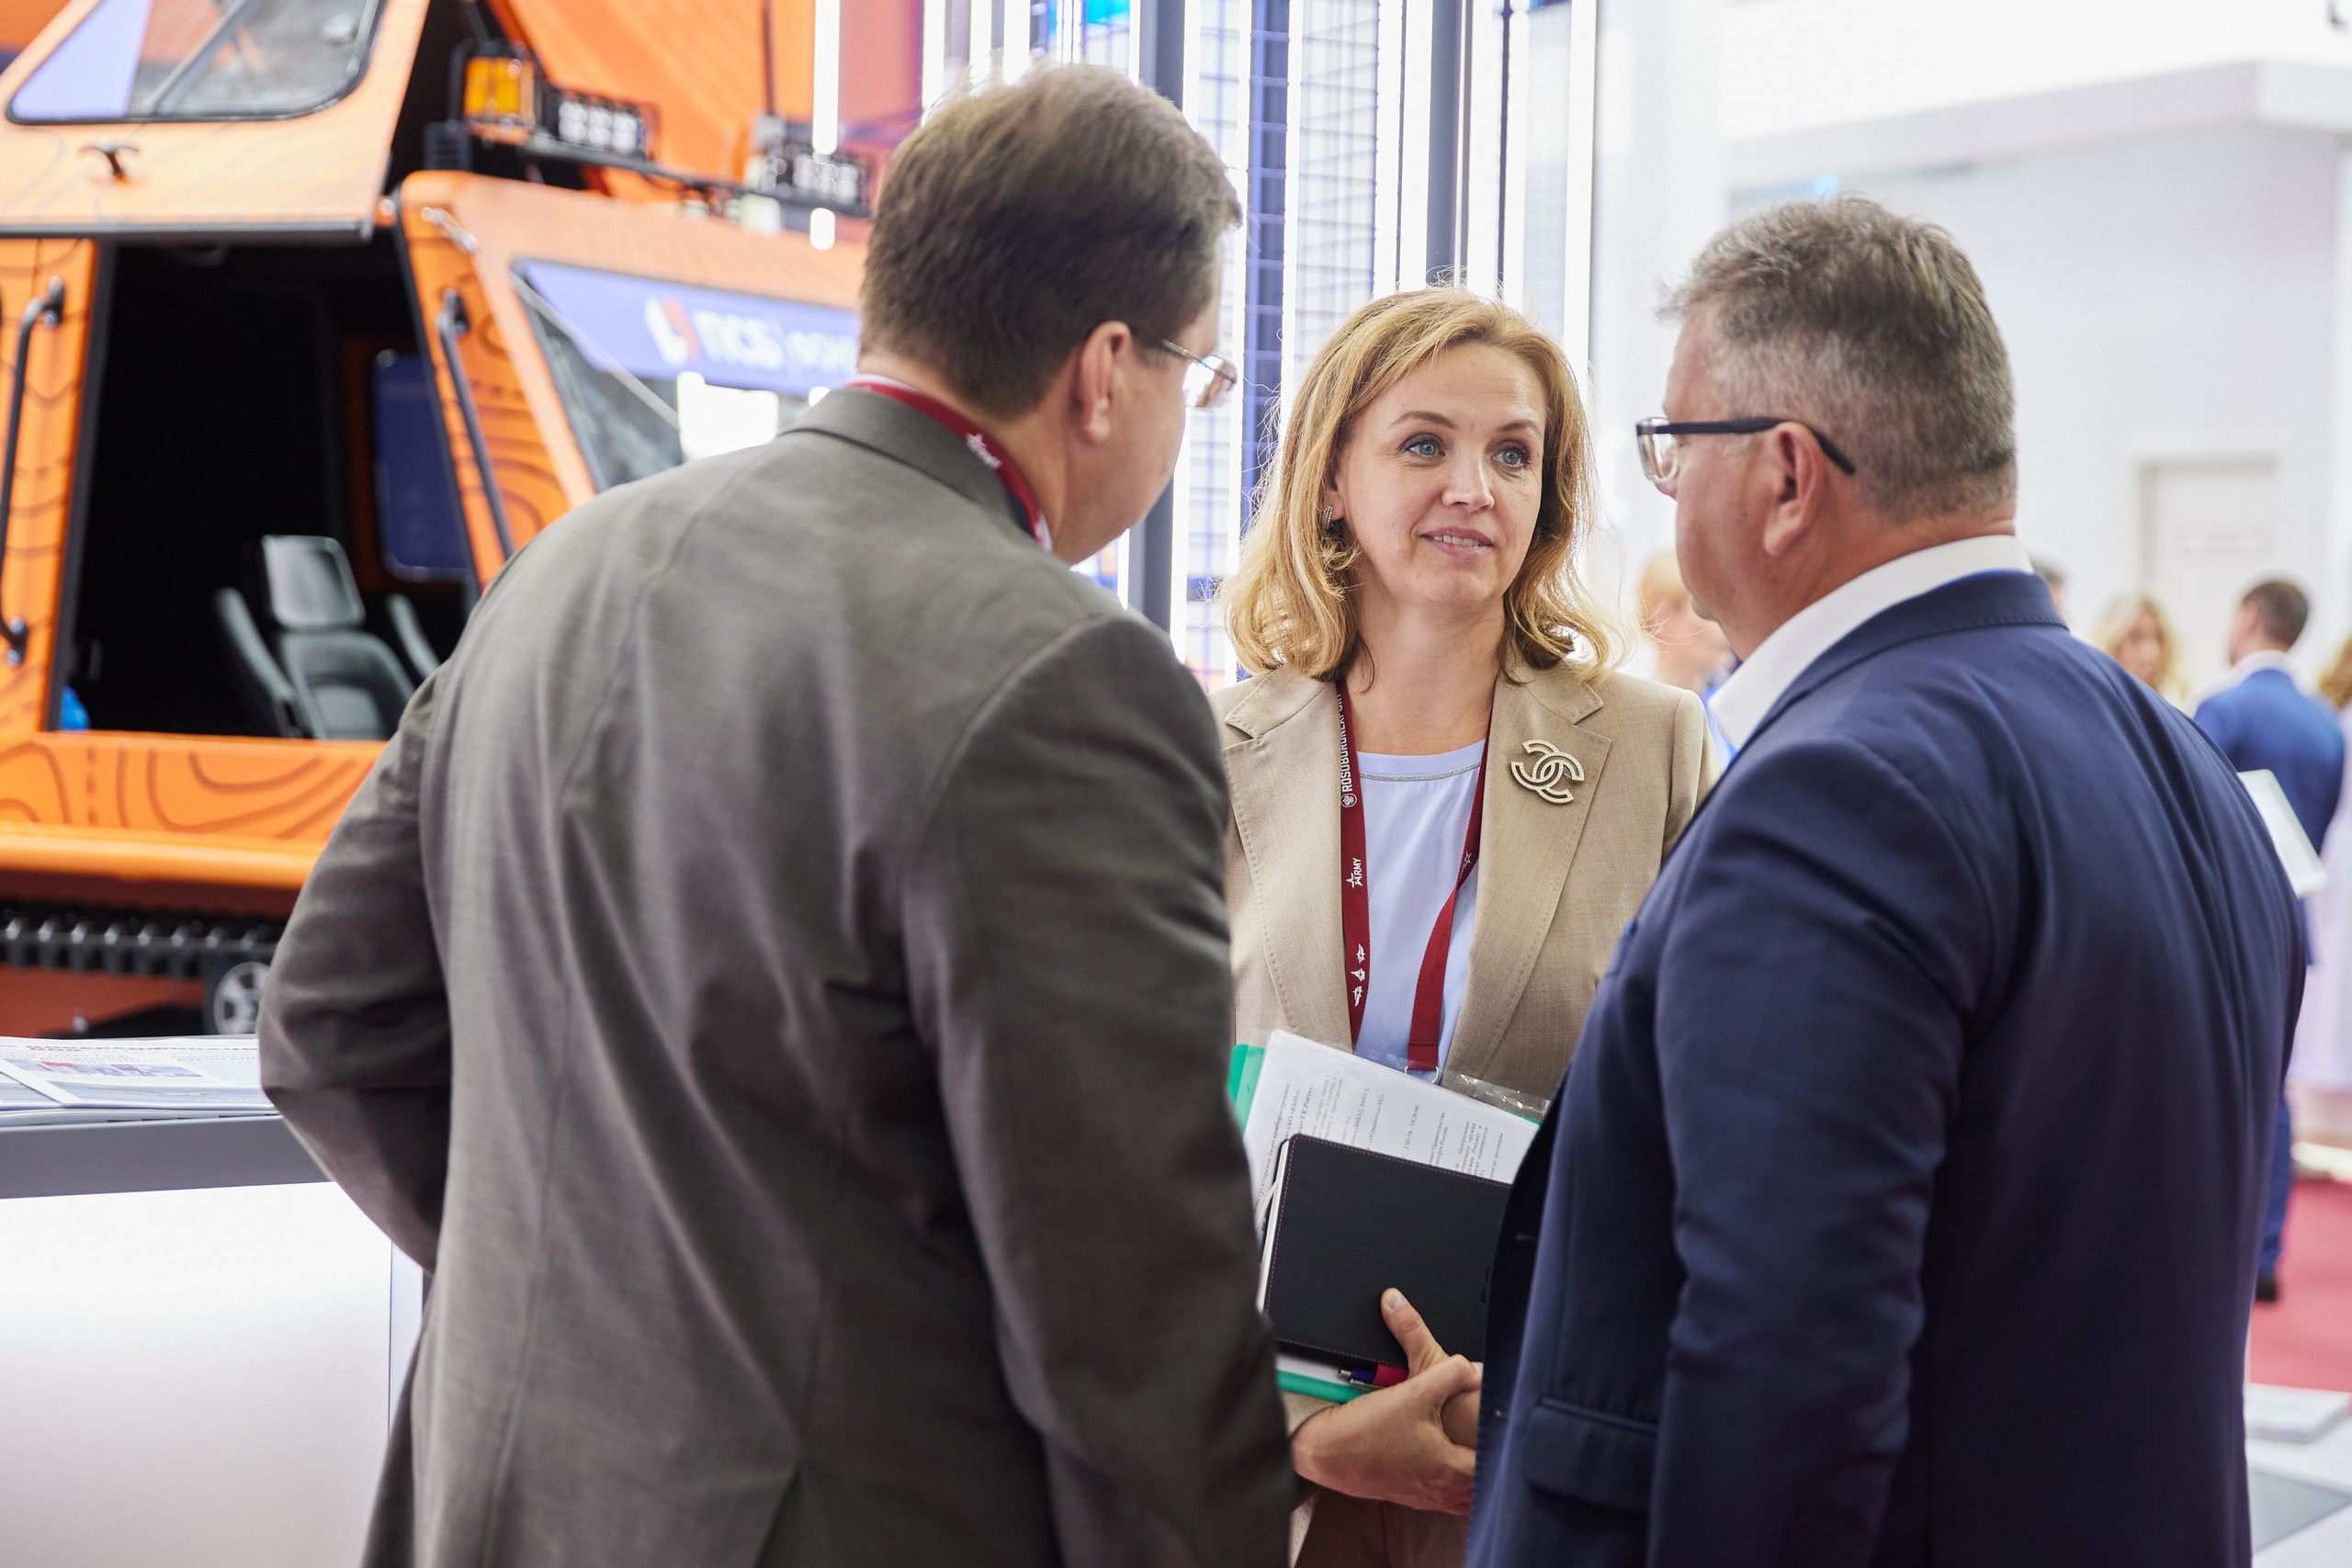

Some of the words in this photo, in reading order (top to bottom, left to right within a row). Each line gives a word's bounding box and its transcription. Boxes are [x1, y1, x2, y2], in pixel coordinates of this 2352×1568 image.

[1272, 1083, 1290, 1139] приборостроения
[1303, 1084, 1315, 1109] Ростех)
[1431, 1111, 1445, 1151] Правительства
[1458, 1121, 1469, 1155] Центральное
[1472, 1133, 1481, 1153] России)
[1478, 1127, 1488, 1159] планируется
[1268, 1139, 1277, 1157] бюро
[1253, 1157, 1272, 1213] онструкторское
